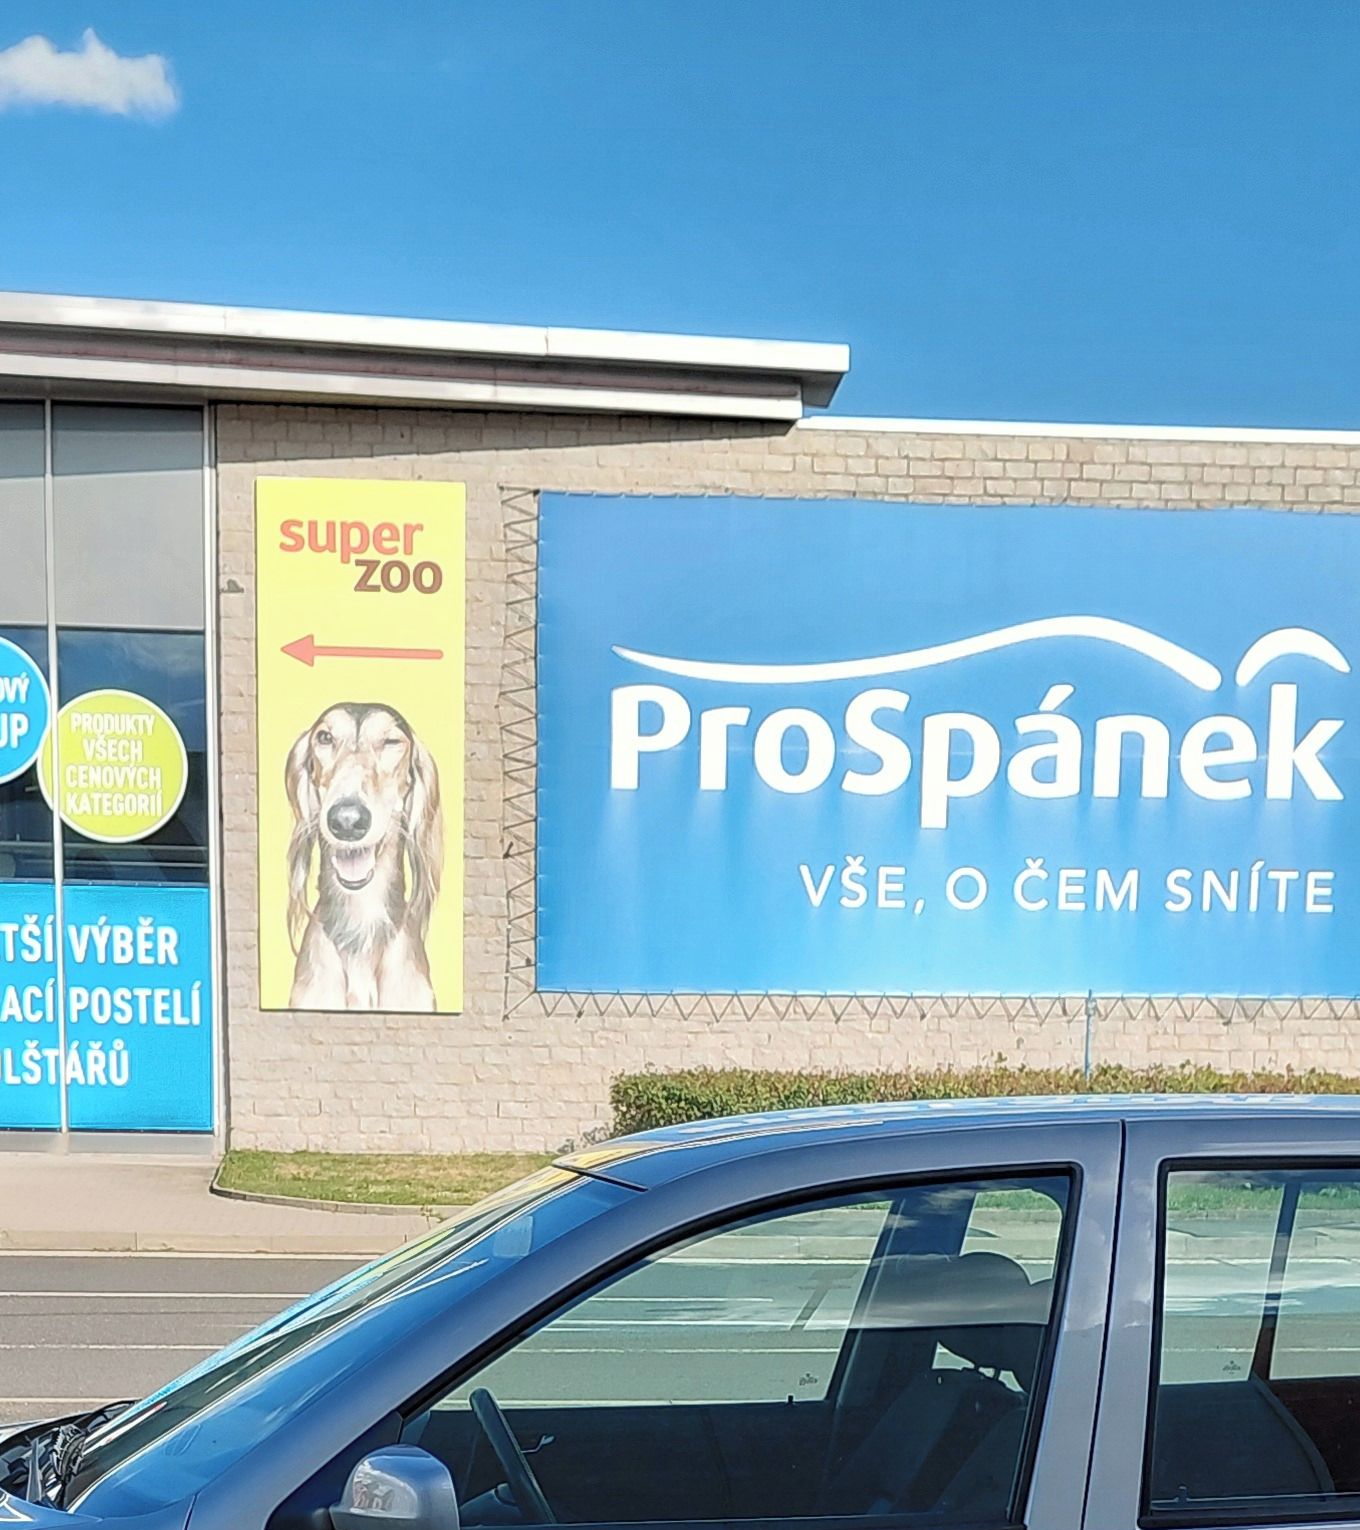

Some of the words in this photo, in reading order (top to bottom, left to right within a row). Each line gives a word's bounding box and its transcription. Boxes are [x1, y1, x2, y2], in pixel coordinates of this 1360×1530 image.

[279, 519, 424, 564] super
[70, 712, 155, 737] PRODUKTY
[83, 734, 143, 762] VŠECH
[611, 683, 1345, 830] ProSpánek
[65, 760, 162, 790] CENOVÝCH
[66, 789, 162, 817] KATEGORIÍ
[798, 856, 926, 915] VŠE,
[945, 866, 989, 912] O
[1013, 857, 1139, 913] ČEM
[1164, 859, 1336, 914] SNÍTE
[67, 916, 179, 965] VÝBĚR
[68, 981, 202, 1026] POSTELÍ
